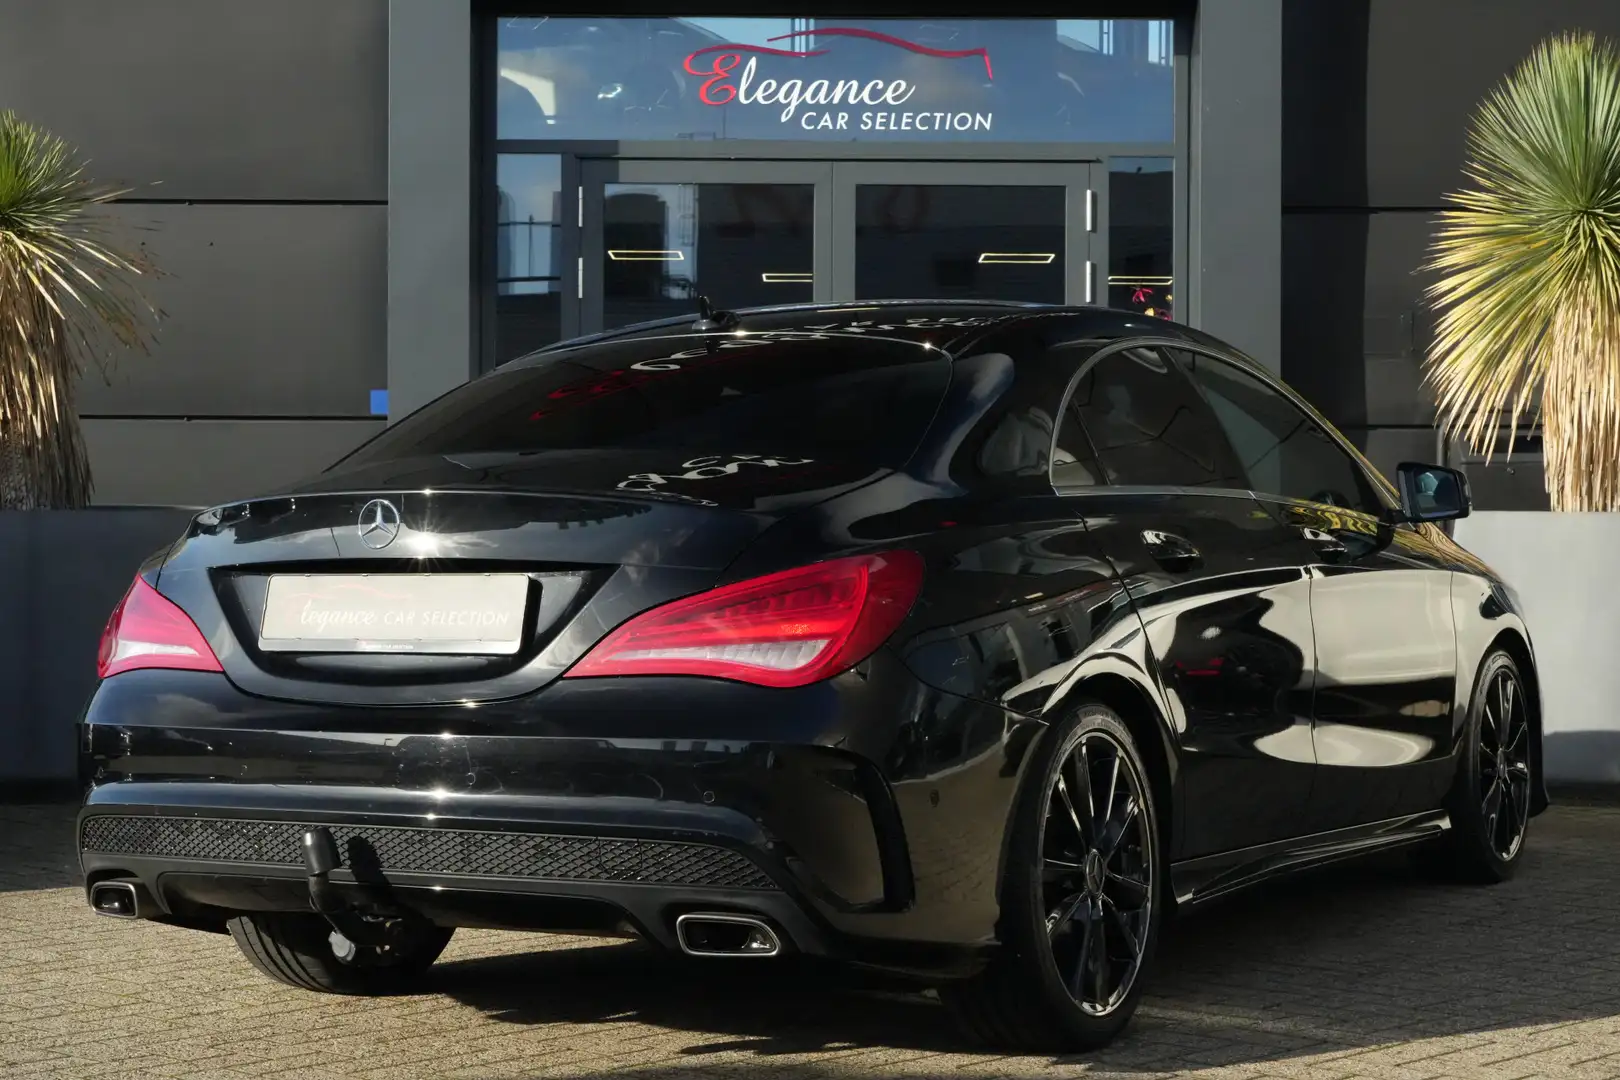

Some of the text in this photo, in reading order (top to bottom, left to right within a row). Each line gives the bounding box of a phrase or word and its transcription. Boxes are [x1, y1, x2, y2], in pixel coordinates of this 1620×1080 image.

[683, 53, 916, 123] Elegance
[800, 111, 993, 131] CAR SELECTION
[286, 597, 510, 633] legance CAR SELECTION
